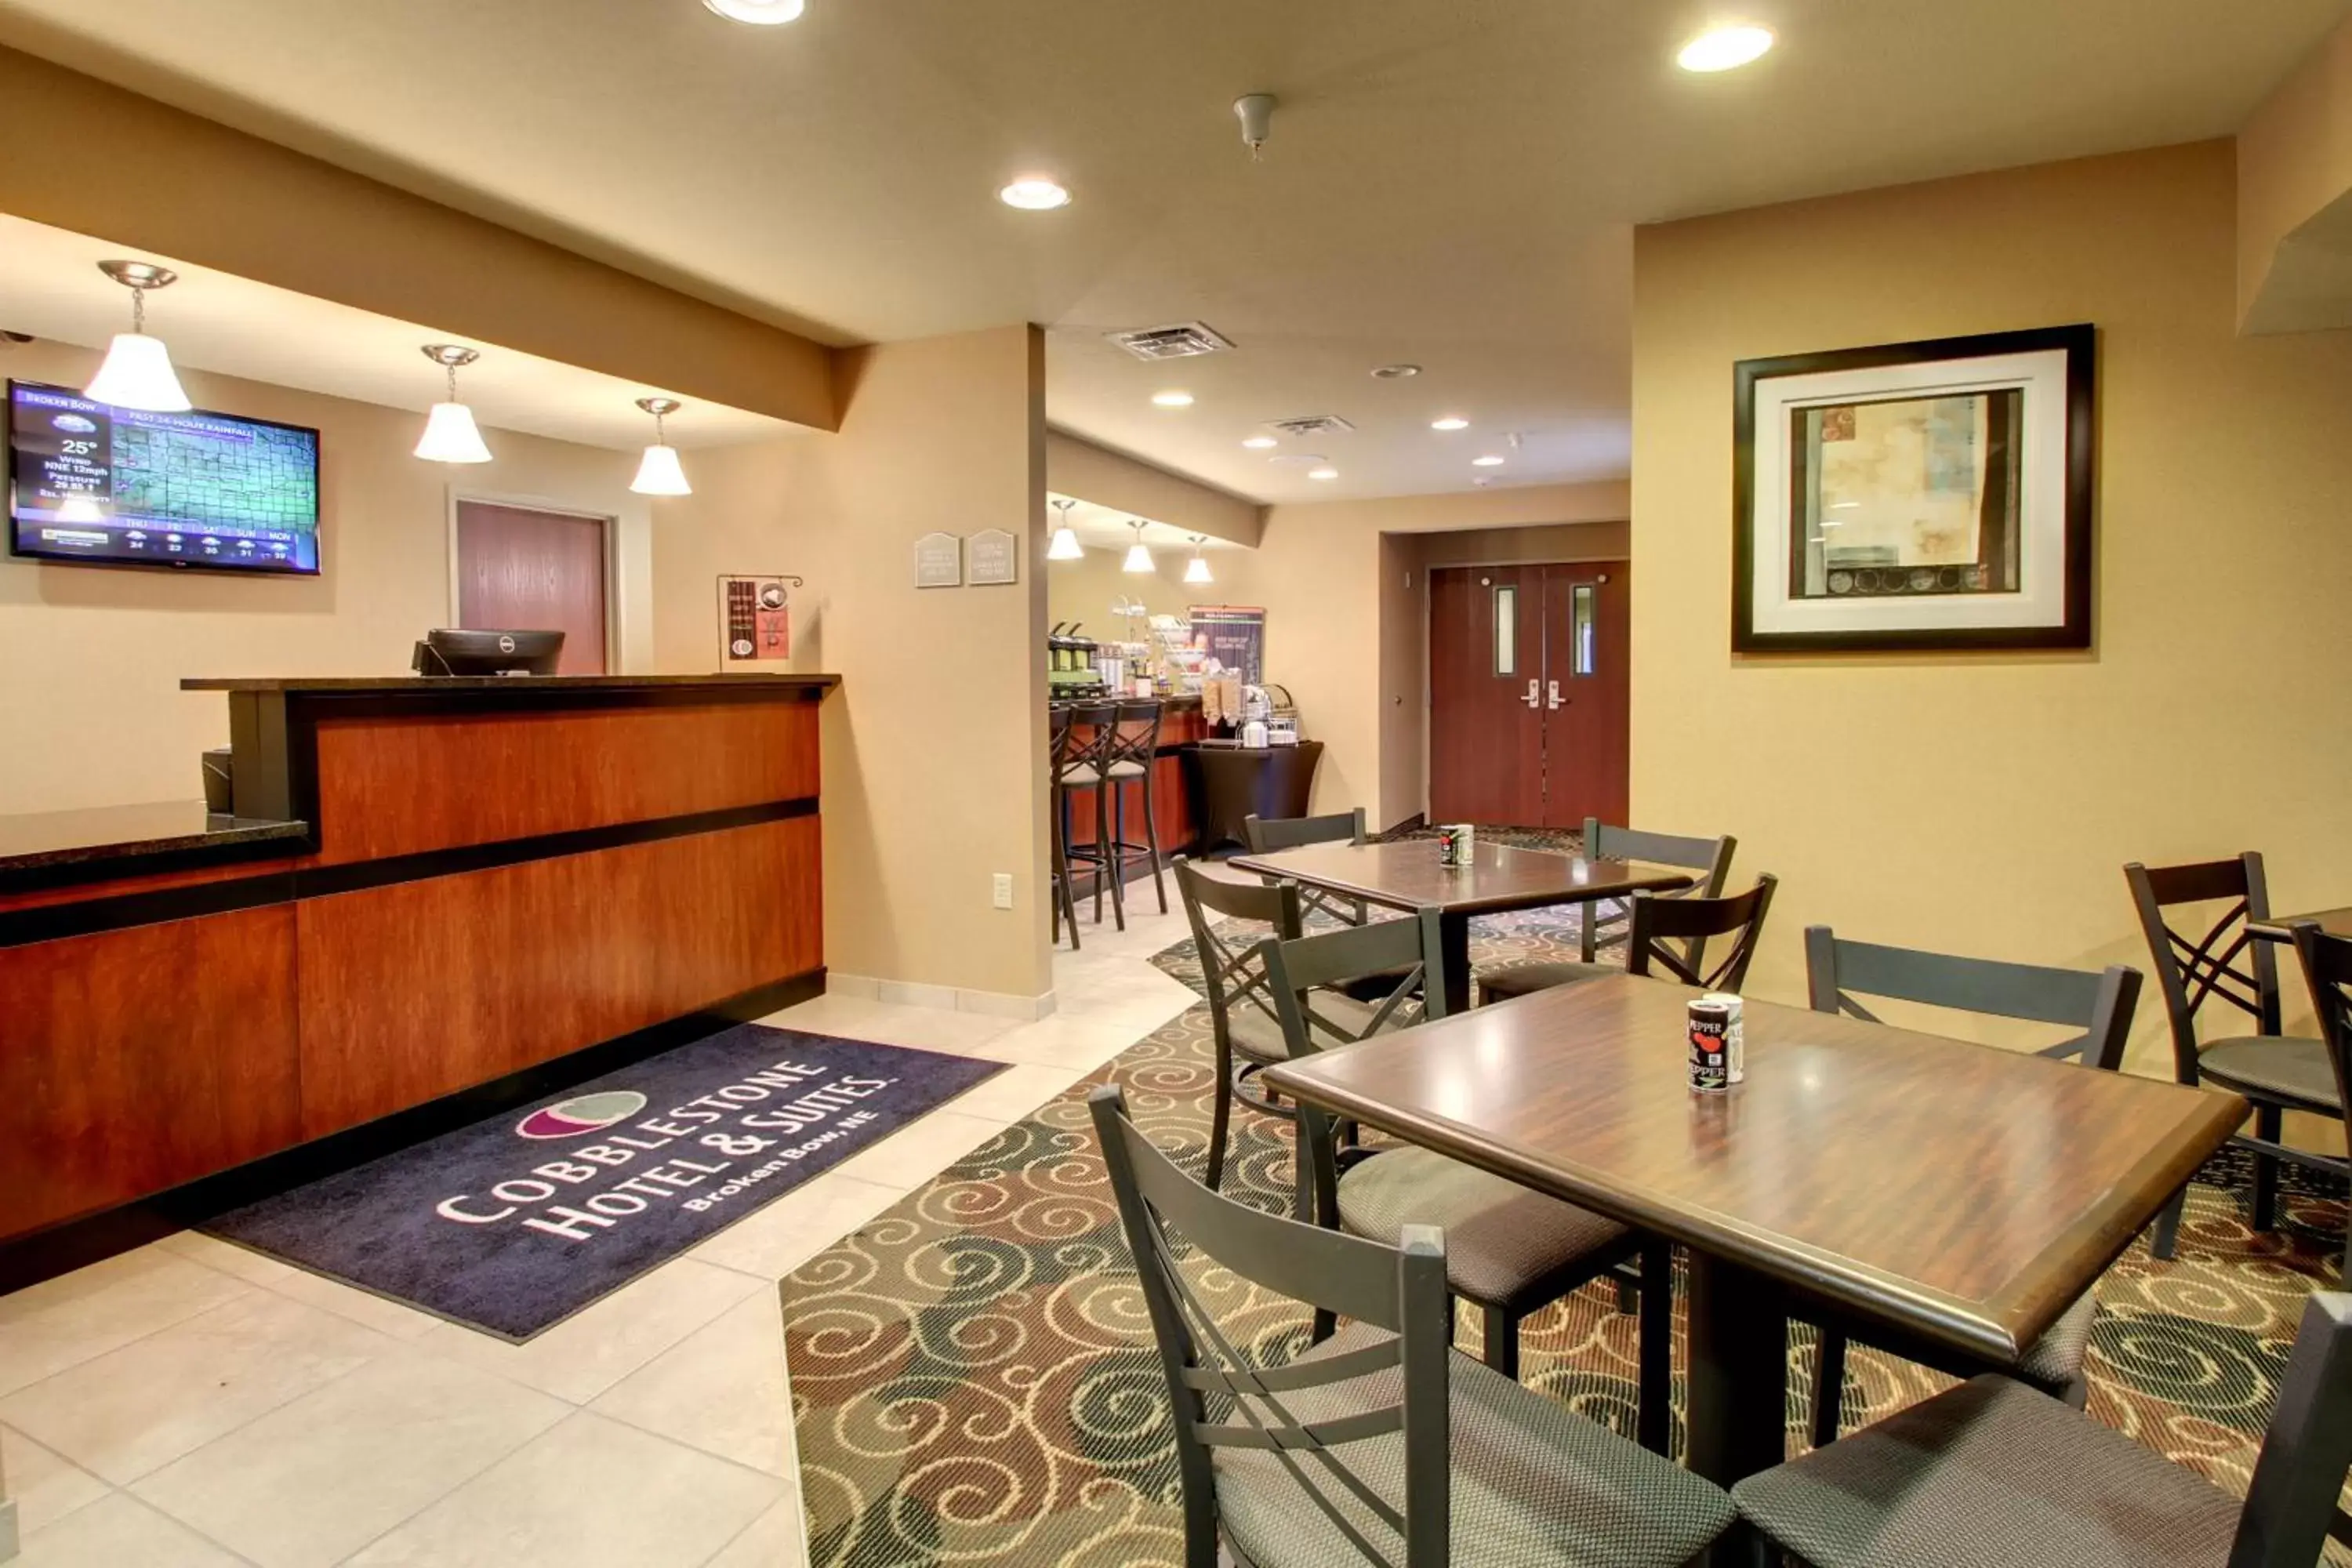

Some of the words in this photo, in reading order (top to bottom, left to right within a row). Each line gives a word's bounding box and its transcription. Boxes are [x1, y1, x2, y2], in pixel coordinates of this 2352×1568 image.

[71, 398, 97, 412] BOW
[45, 461, 71, 471] NNE
[269, 532, 291, 541] MON
[1689, 1064, 1726, 1077] EPPER
[436, 1060, 828, 1223] COBBLESTONE
[521, 1158, 735, 1242] HOTEL
[700, 1133, 779, 1156] &
[741, 1075, 887, 1138] SUITES
[681, 1160, 790, 1212] Broken
[779, 1131, 848, 1160] Bow,
[837, 1110, 880, 1129] NE
